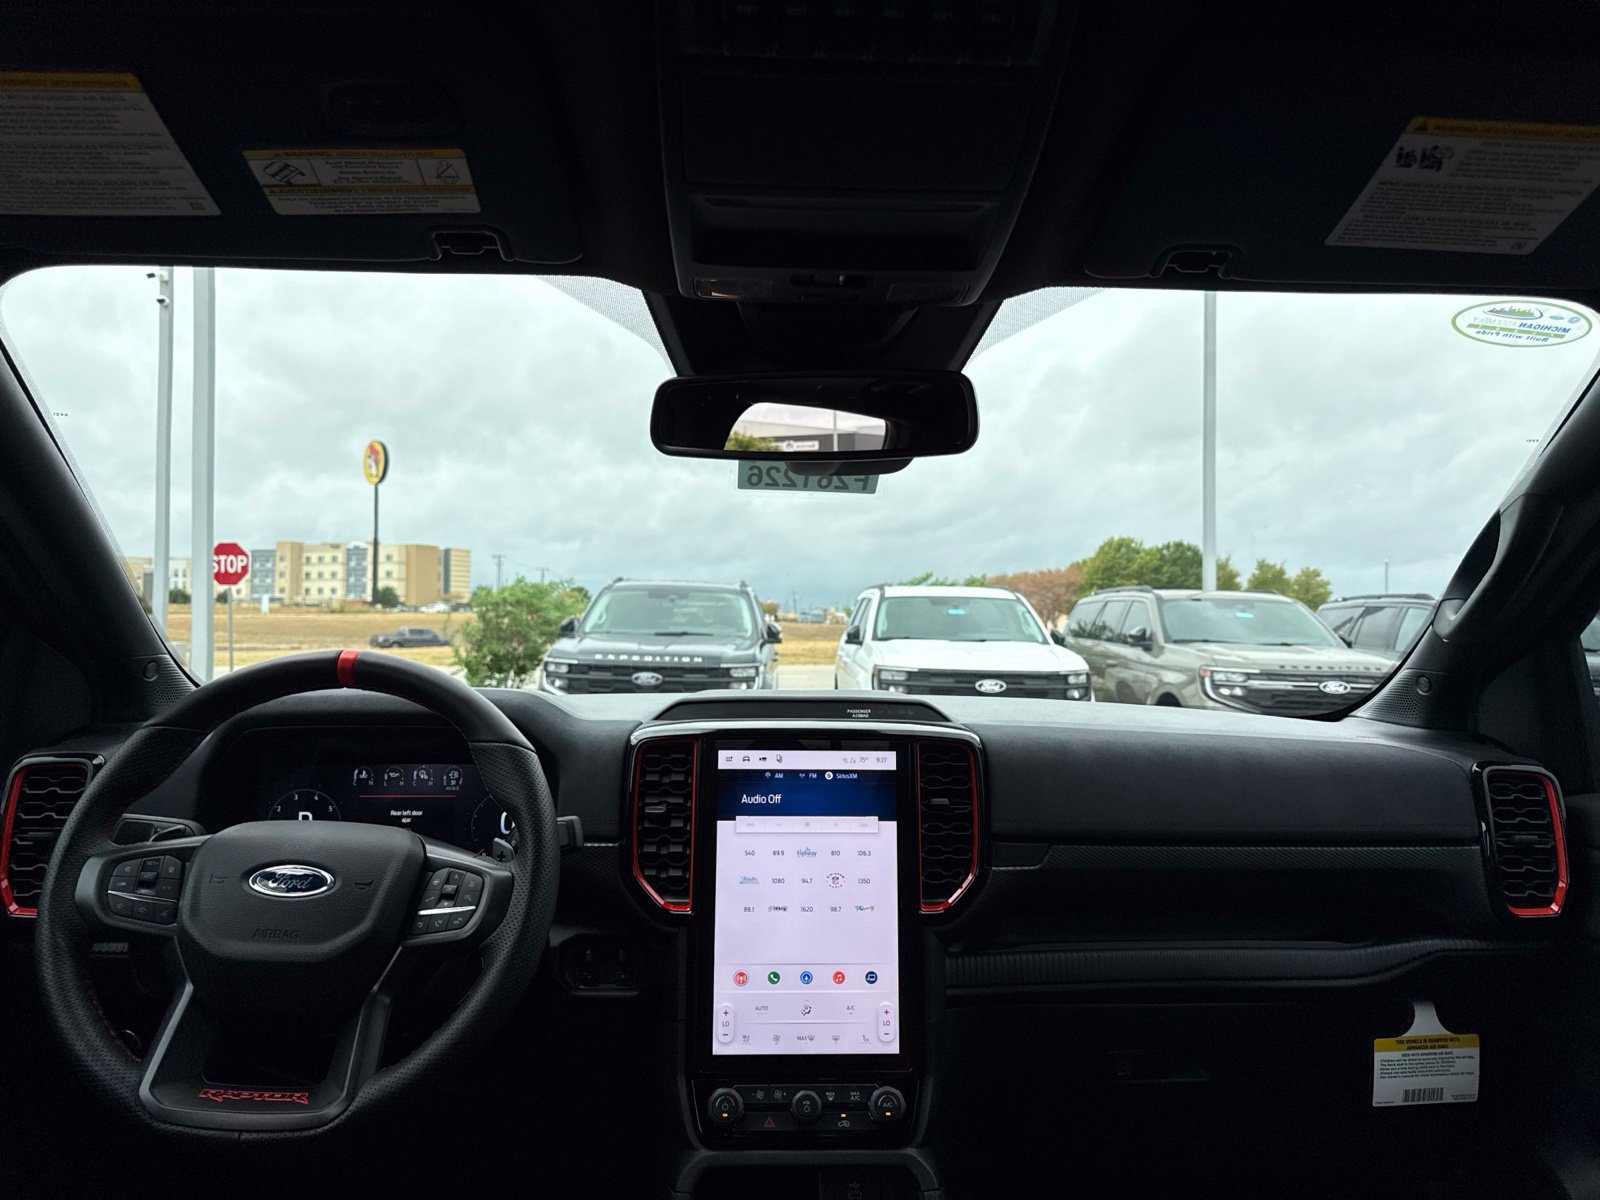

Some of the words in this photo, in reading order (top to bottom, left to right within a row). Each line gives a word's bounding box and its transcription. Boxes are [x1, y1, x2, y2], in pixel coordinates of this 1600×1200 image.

[212, 554, 248, 574] STOP
[594, 653, 703, 663] EXPEDITION
[836, 772, 858, 780] SiriusXM
[741, 794, 767, 804] Audio
[768, 794, 782, 804] Off
[268, 872, 313, 890] Ford
[251, 928, 299, 938] AIRBAG
[198, 1088, 309, 1105] RAPTOR
